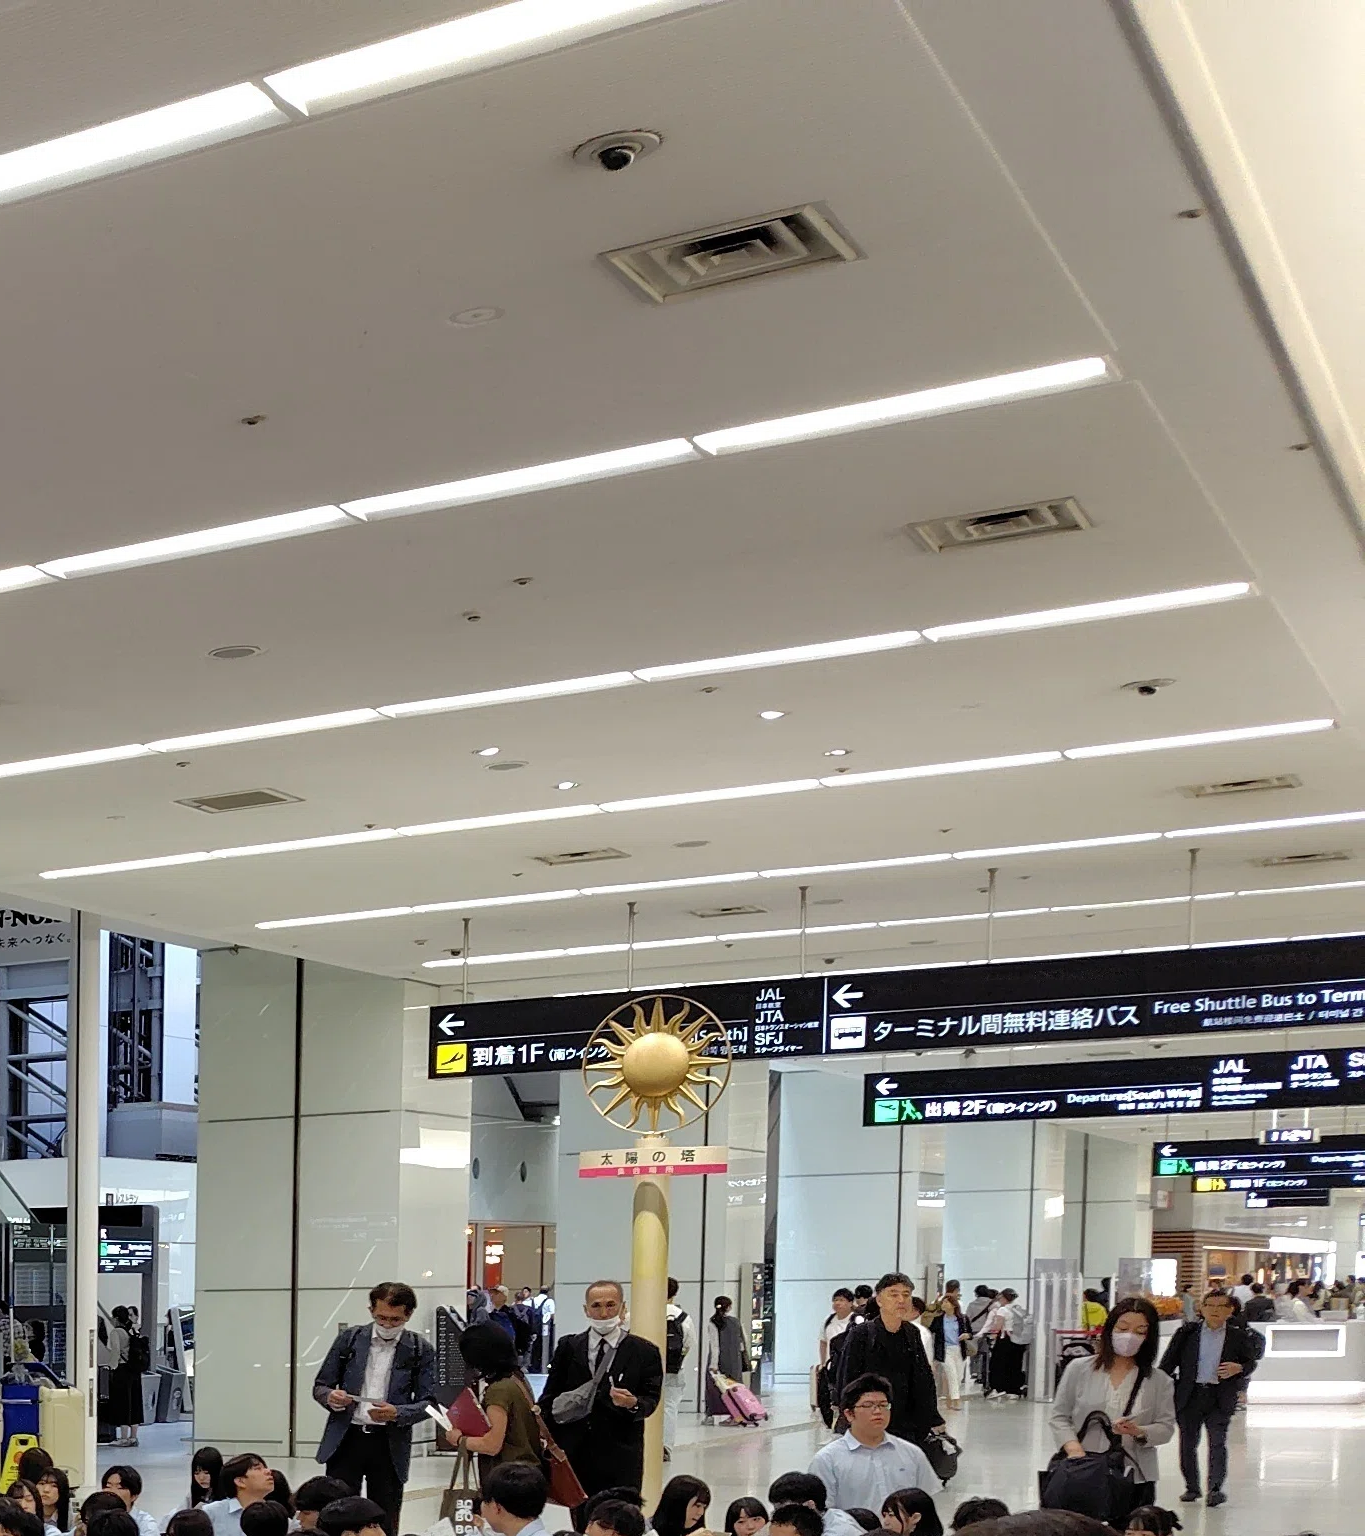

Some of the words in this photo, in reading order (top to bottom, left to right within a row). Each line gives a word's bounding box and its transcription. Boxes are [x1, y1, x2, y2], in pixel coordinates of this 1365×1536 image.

[755, 988, 786, 1001] JAL
[1153, 1001, 1191, 1014] Free
[1194, 995, 1257, 1012] Shuttle
[1261, 994, 1293, 1008] Bus
[1297, 991, 1317, 1005] to
[755, 1010, 785, 1023] JTA
[873, 1005, 1140, 1042] ターミナル間無料連絡バス
[754, 1032, 783, 1045] SFJ
[1212, 1059, 1251, 1074] JAL
[1290, 1055, 1329, 1070] JTA
[601, 1150, 696, 1166] 太陽の塔
